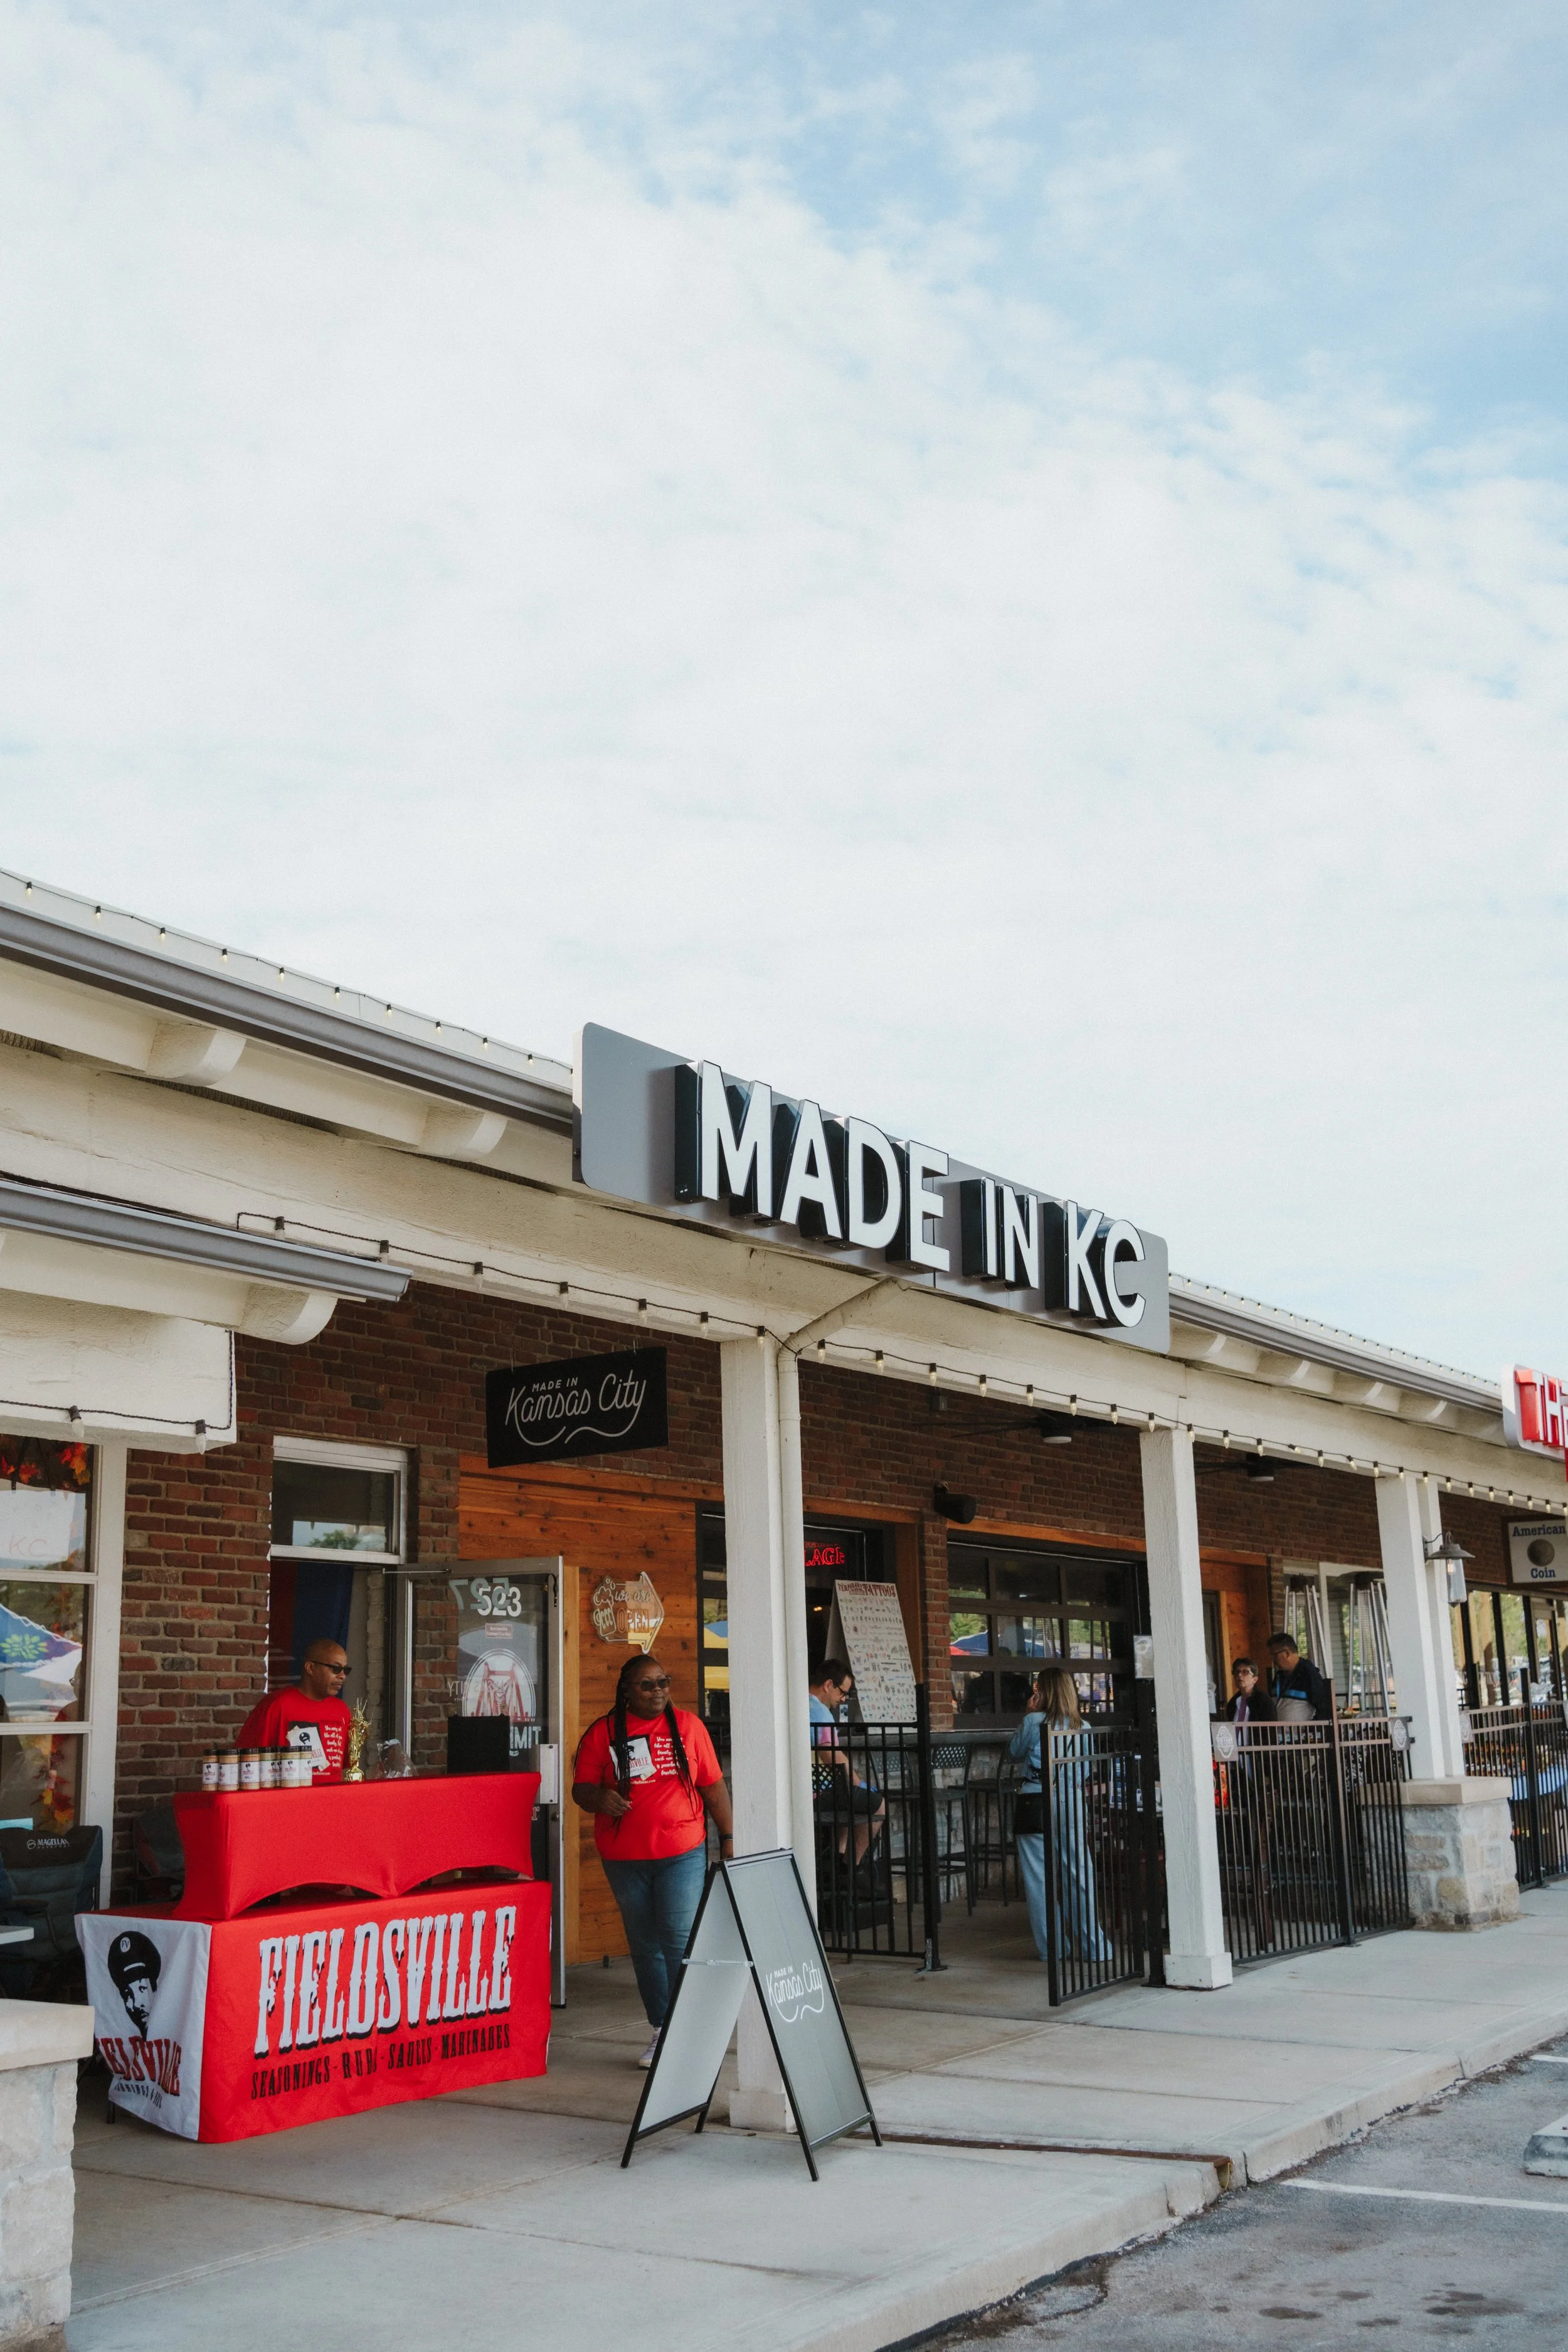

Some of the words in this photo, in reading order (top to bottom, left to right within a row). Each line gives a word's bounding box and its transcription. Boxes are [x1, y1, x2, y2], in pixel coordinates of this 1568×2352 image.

[690, 1059, 950, 1273] MADE
[975, 1177, 1040, 1290] IN
[1060, 1200, 1147, 1328] KC
[531, 1379, 563, 1392] MADE
[566, 1377, 578, 1387] IN
[505, 1386, 591, 1433] Kansas
[1512, 1524, 1567, 1537] American
[1530, 1567, 1556, 1579] Coin
[477, 1586, 522, 1617] 523
[615, 1590, 630, 1601] we
[633, 1589, 651, 1602] are
[862, 1583, 896, 1597] TATTOOS
[617, 1608, 650, 1633] OPEN
[253, 1905, 517, 2060] FIELDSVILLE
[774, 1967, 787, 1979] MADE
[787, 1965, 793, 1974] IN
[766, 1973, 805, 2012] Kansas
[802, 1959, 824, 2001] City
[251, 2055, 330, 2100] SEASONINGS
[388, 2037, 432, 2070] SAUCES
[440, 2023, 511, 2060] MARINADES
